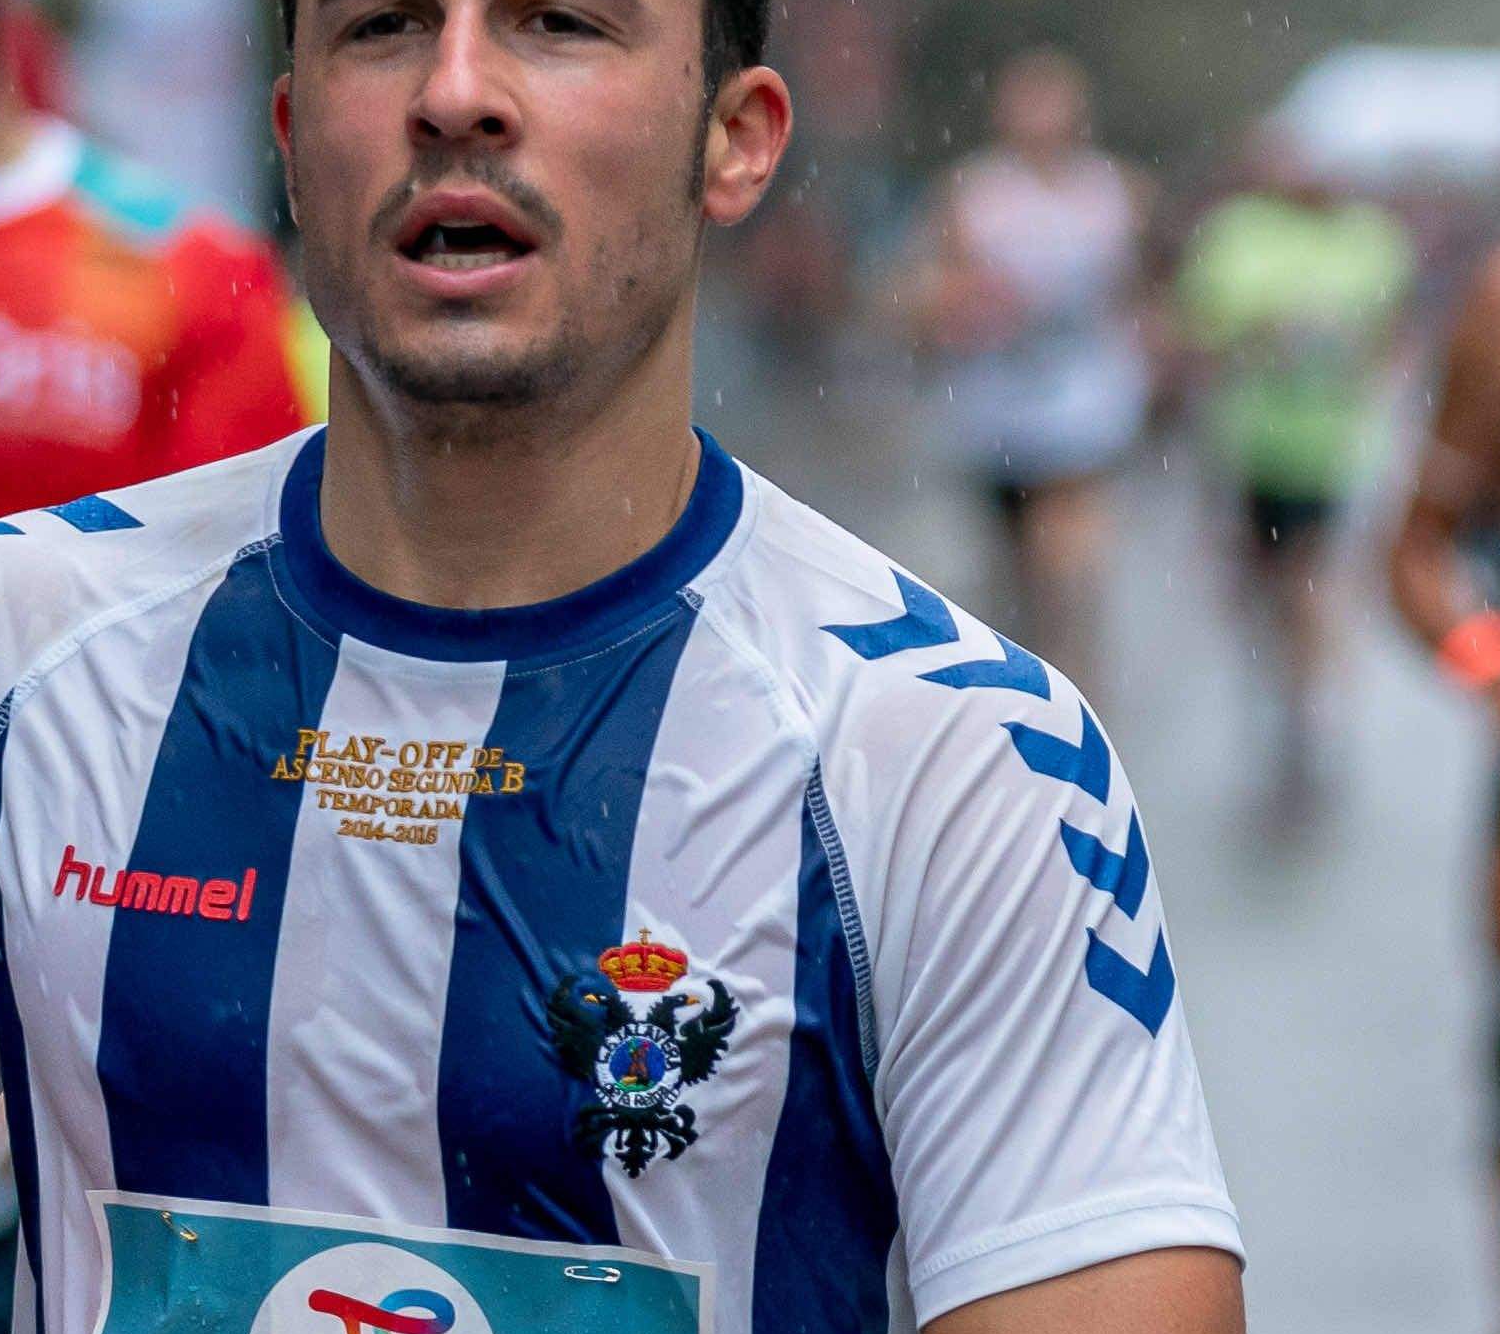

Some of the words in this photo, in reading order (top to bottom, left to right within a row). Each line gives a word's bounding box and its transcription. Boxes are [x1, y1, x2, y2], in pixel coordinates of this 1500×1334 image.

[297, 728, 467, 769] PLAY-OFF
[473, 747, 505, 768] DE
[270, 754, 385, 790] ASCENSO
[387, 768, 494, 794] SEGUNDA
[499, 762, 526, 793] B
[315, 789, 464, 820] TEMPORADA
[53, 844, 257, 922] hummel
